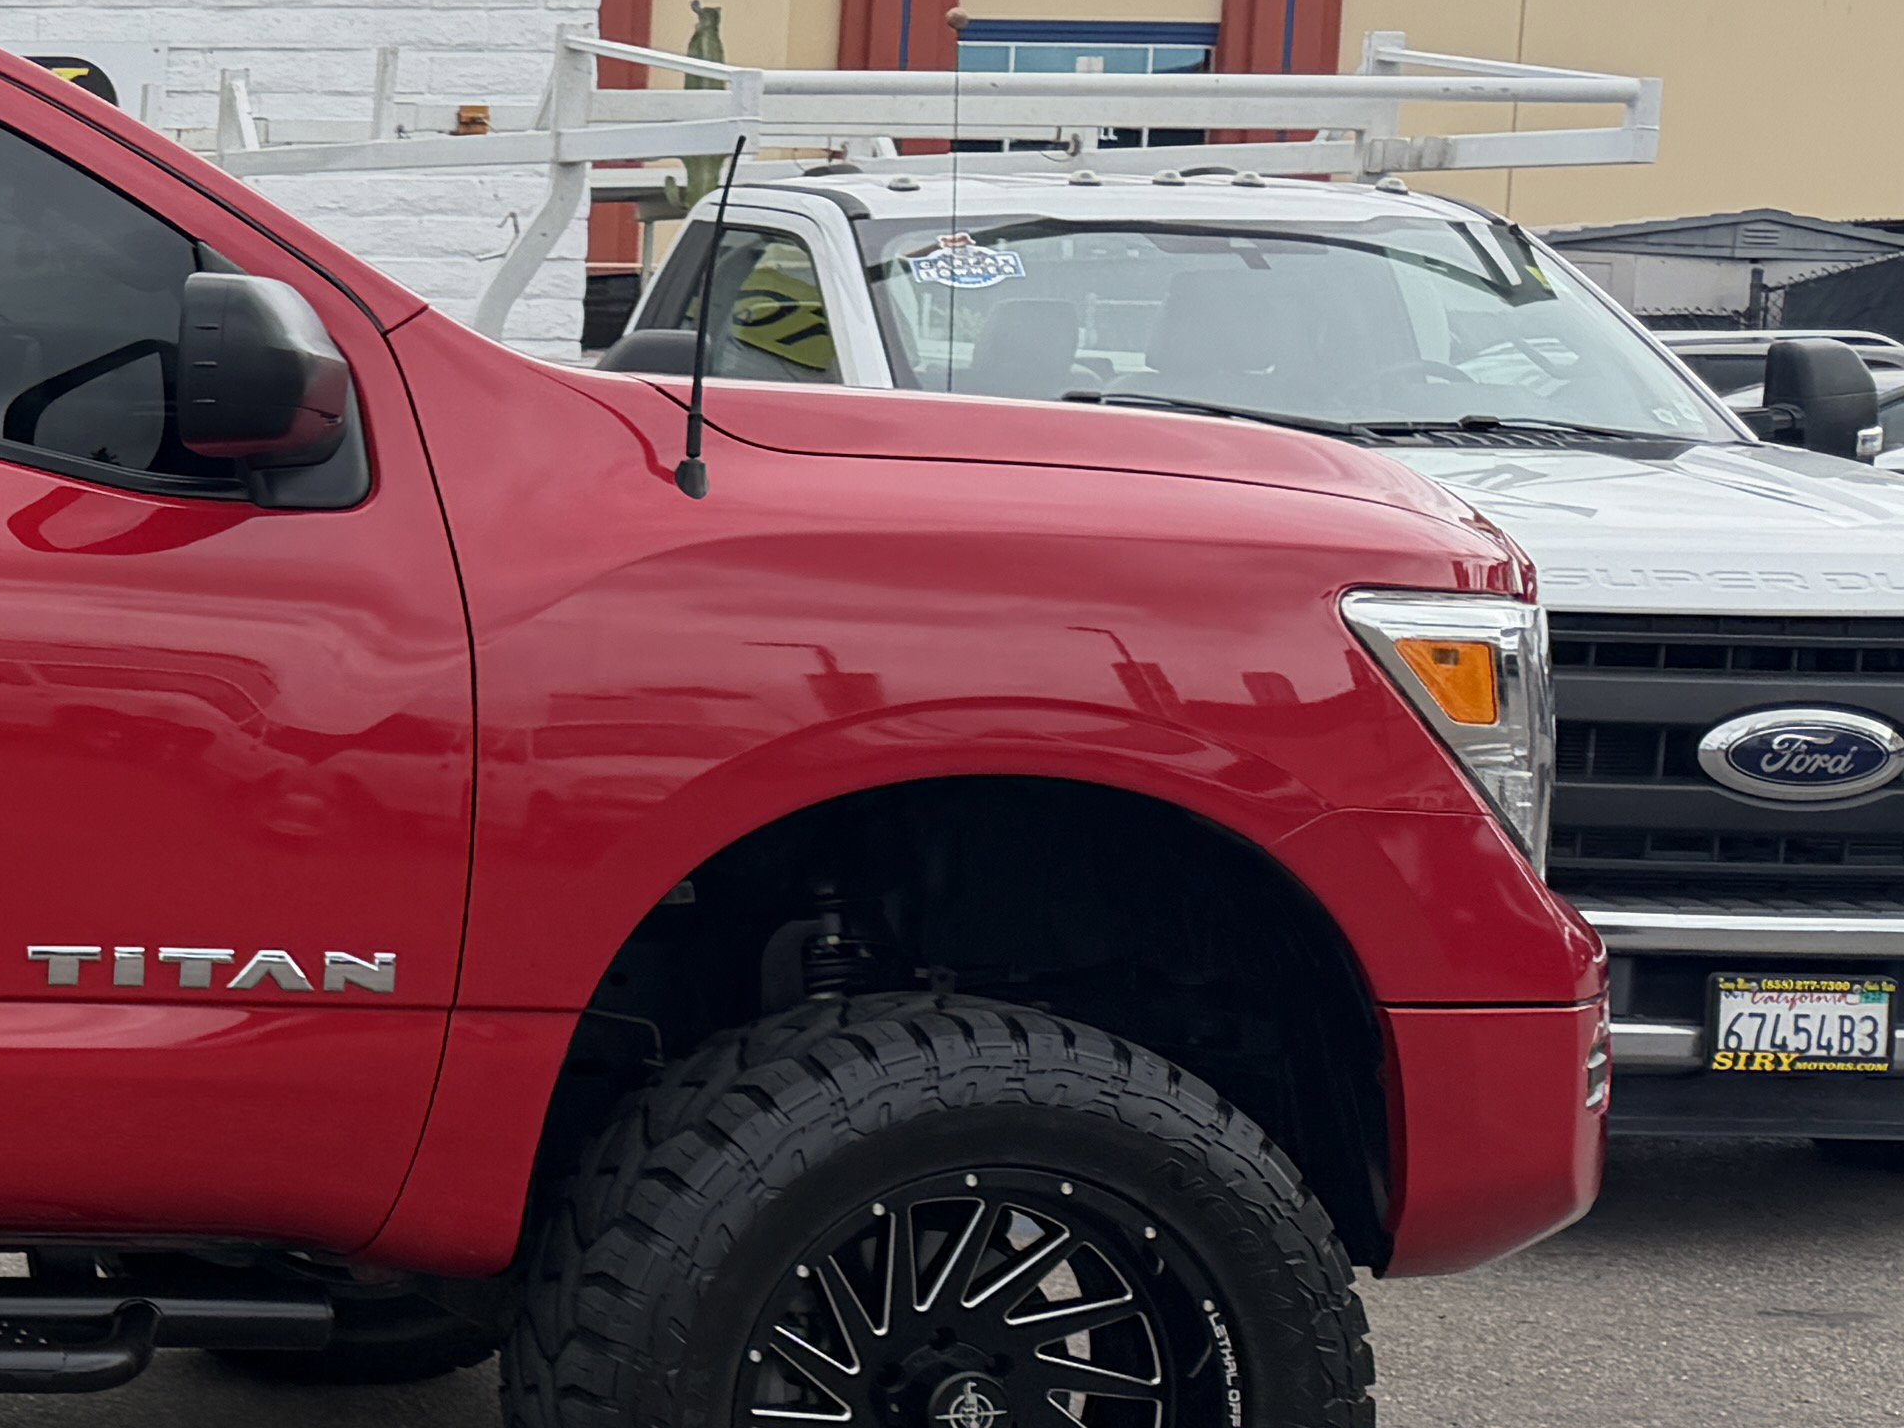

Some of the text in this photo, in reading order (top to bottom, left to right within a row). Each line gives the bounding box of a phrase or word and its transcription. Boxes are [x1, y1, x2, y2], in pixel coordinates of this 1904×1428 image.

[1540, 567, 1811, 592] SUPER
[1760, 733, 1858, 775] Ford
[26, 945, 397, 993] TITAN
[1751, 990, 1860, 1011] California
[1723, 1012, 1879, 1056] 67454B3
[1712, 1051, 1801, 1072] SIRY
[1208, 1311, 1240, 1387] LETHAL
[1227, 1388, 1242, 1428] OFF
